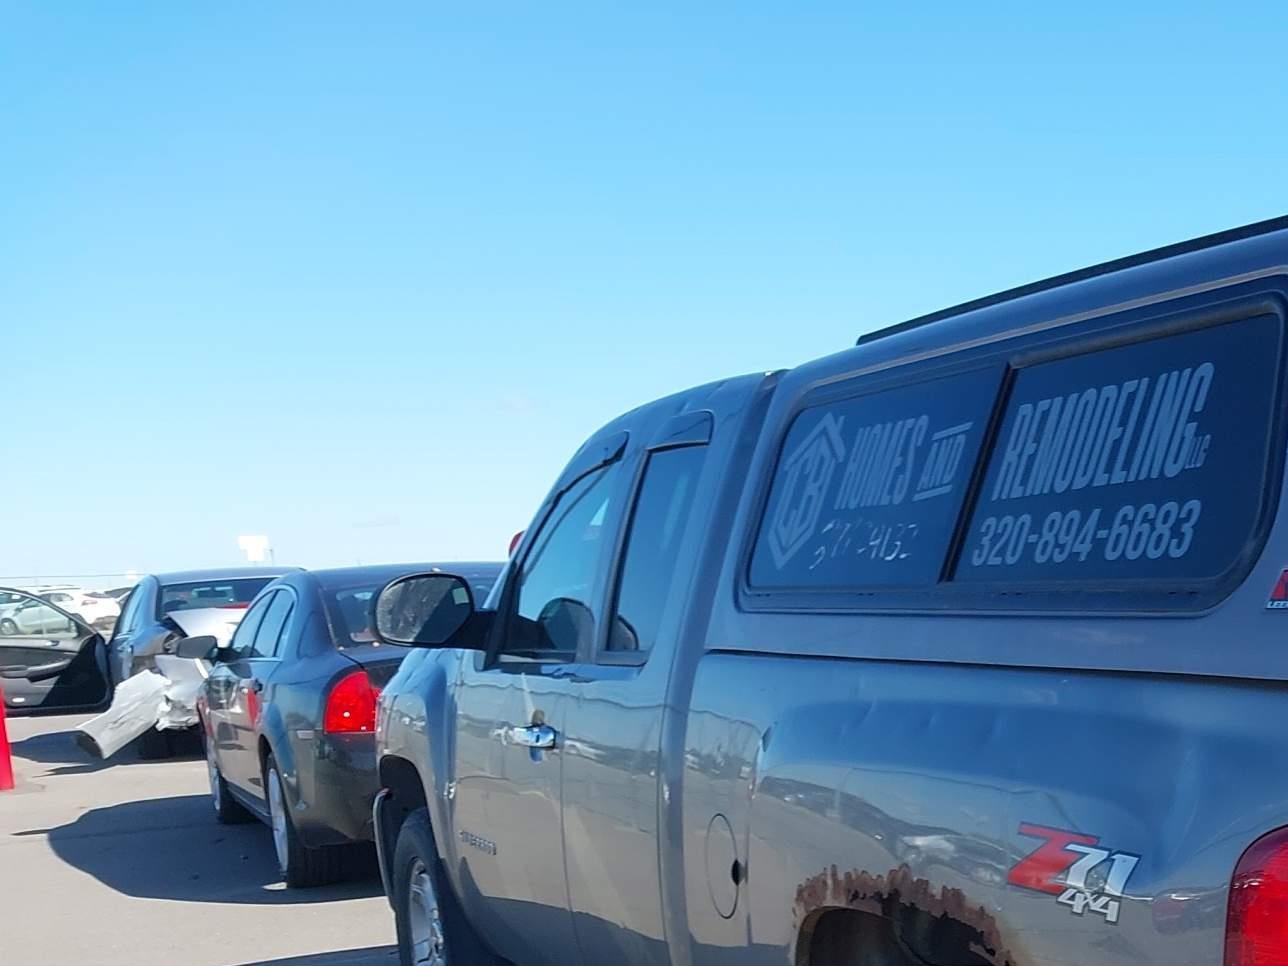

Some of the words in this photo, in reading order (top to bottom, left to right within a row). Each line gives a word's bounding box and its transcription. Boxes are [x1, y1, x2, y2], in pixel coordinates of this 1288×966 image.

[833, 415, 929, 510] HOMES
[916, 434, 966, 491] AND
[991, 362, 1215, 501] REMODELING
[971, 499, 1201, 567] 320-894-6683
[1007, 821, 1141, 897] Z71
